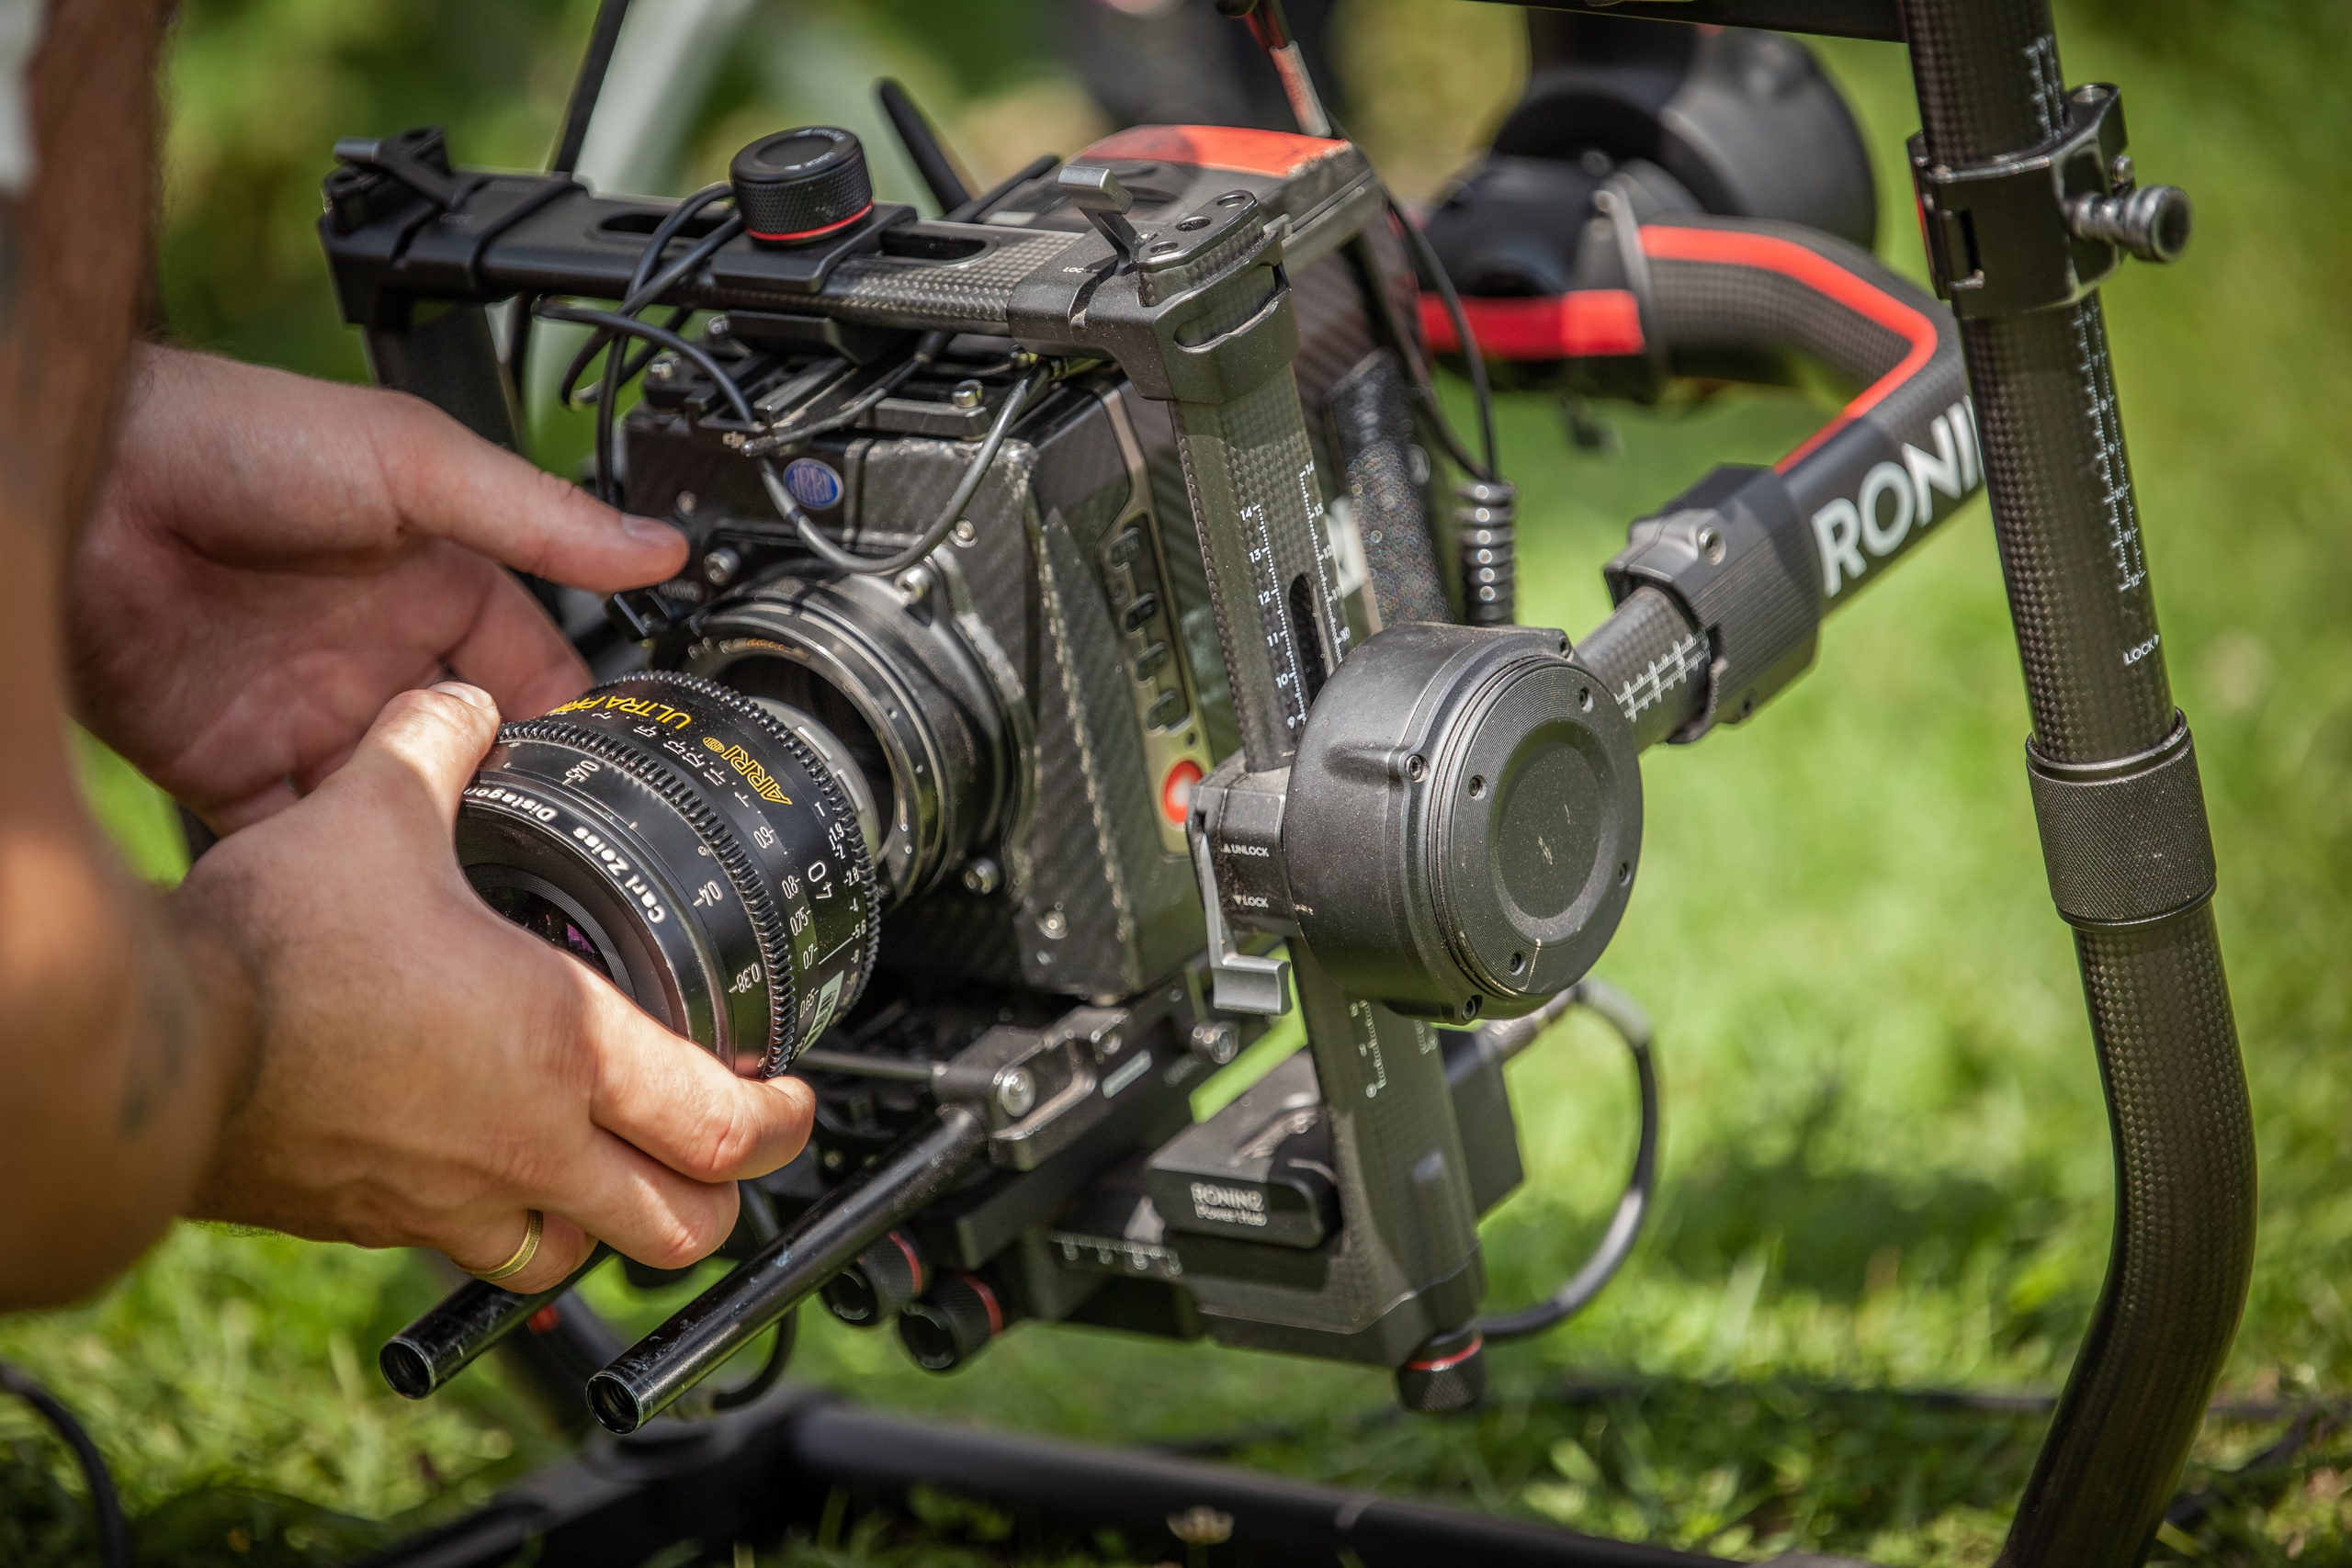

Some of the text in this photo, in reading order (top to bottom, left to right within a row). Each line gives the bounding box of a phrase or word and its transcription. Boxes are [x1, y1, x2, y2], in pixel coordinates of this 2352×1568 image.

[2099, 398, 2109, 413] 8
[2108, 442, 2116, 456] 9
[1306, 460, 1315, 475] 14
[1811, 394, 1984, 598] RONI
[2115, 486, 2125, 501] 10
[1239, 507, 1253, 521] 14
[2123, 530, 2132, 544] 11
[1249, 549, 1261, 563] 13
[2130, 573, 2141, 588] 12
[1258, 592, 1271, 606] 12
[1267, 633, 1279, 647] 11
[2123, 637, 2154, 666] LOCK
[1276, 673, 1289, 688] 10
[605, 695, 692, 730] ULTRA
[1287, 716, 1295, 729] 9
[565, 760, 601, 784] 0.45
[720, 744, 793, 806] ARRI
[814, 801, 826, 818] T
[753, 826, 774, 850] 0.9
[829, 822, 844, 842] 1.9
[463, 786, 666, 924] Carl Zeiss Distagon
[1231, 843, 1270, 858] UNLOCK
[781, 874, 799, 899] 0.8
[808, 861, 832, 900] 40
[697, 879, 724, 908] 0.4
[1243, 894, 1270, 908] LOCK
[802, 942, 814, 970] 0.7
[736, 962, 762, 994] 0.38
